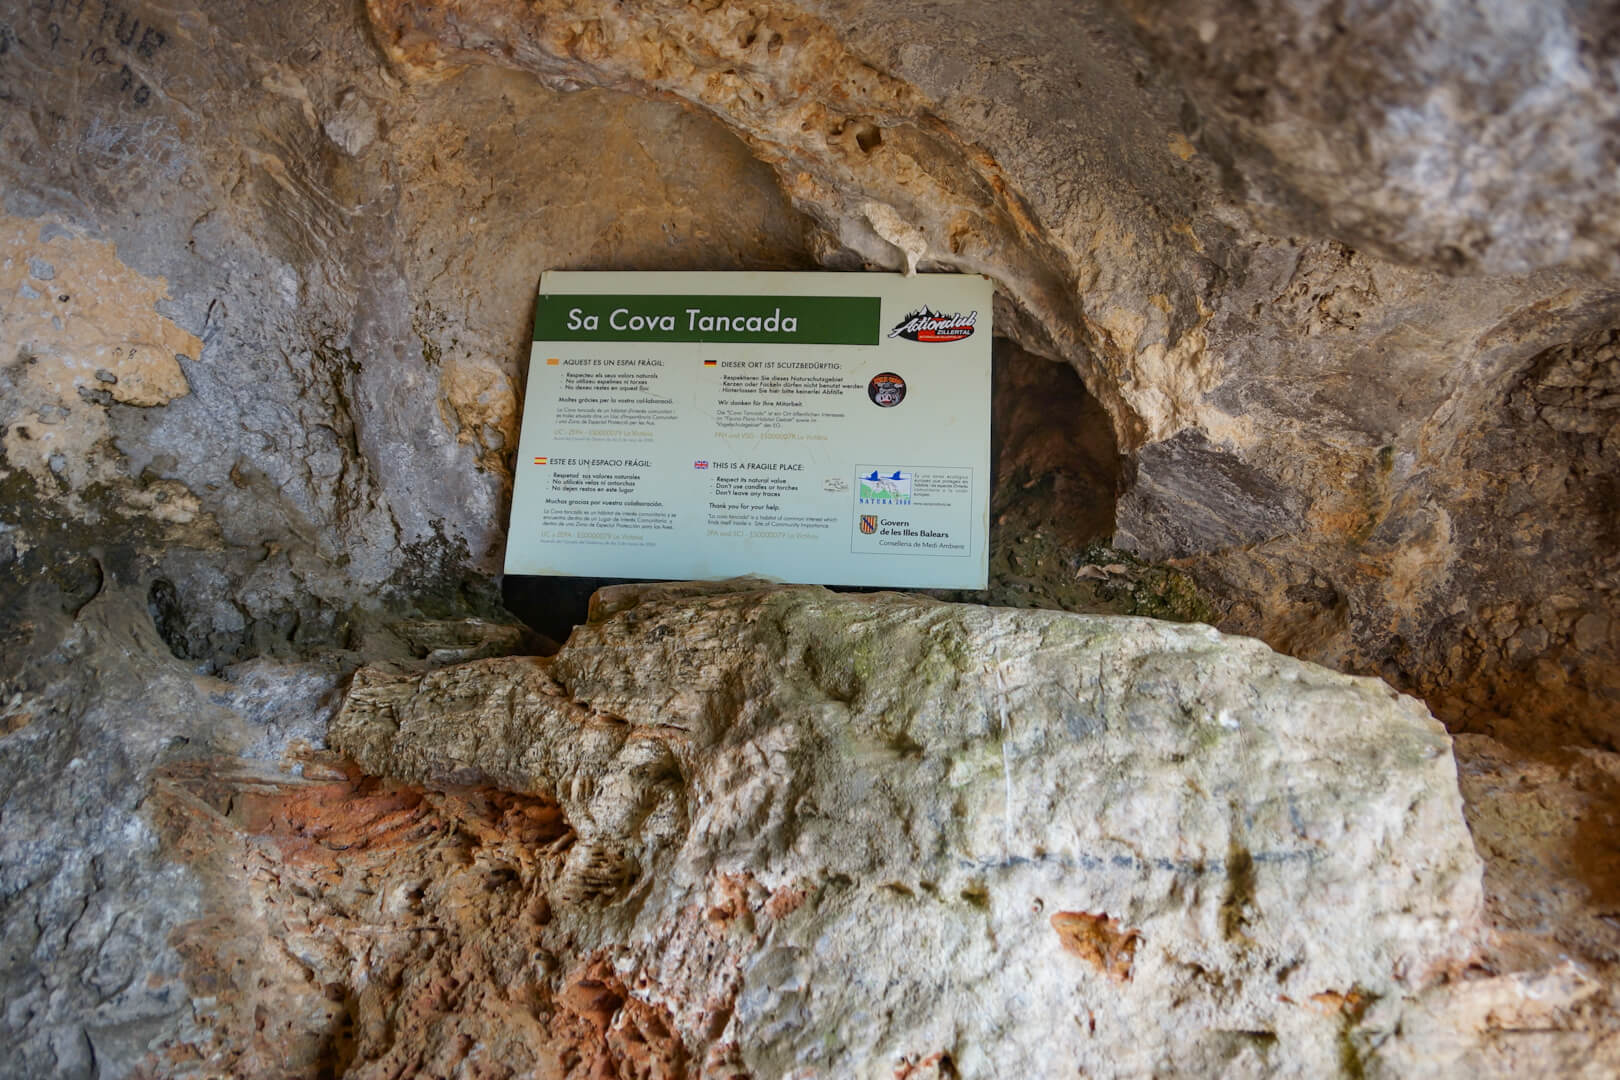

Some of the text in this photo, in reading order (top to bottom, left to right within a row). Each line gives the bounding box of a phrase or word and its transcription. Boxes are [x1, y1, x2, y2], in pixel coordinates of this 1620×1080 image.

[567, 307, 798, 332] Sa Cova Tancada
[625, 458, 652, 467] FRÁGIL:
[880, 519, 909, 527] Govern
[920, 530, 950, 538] Balears
